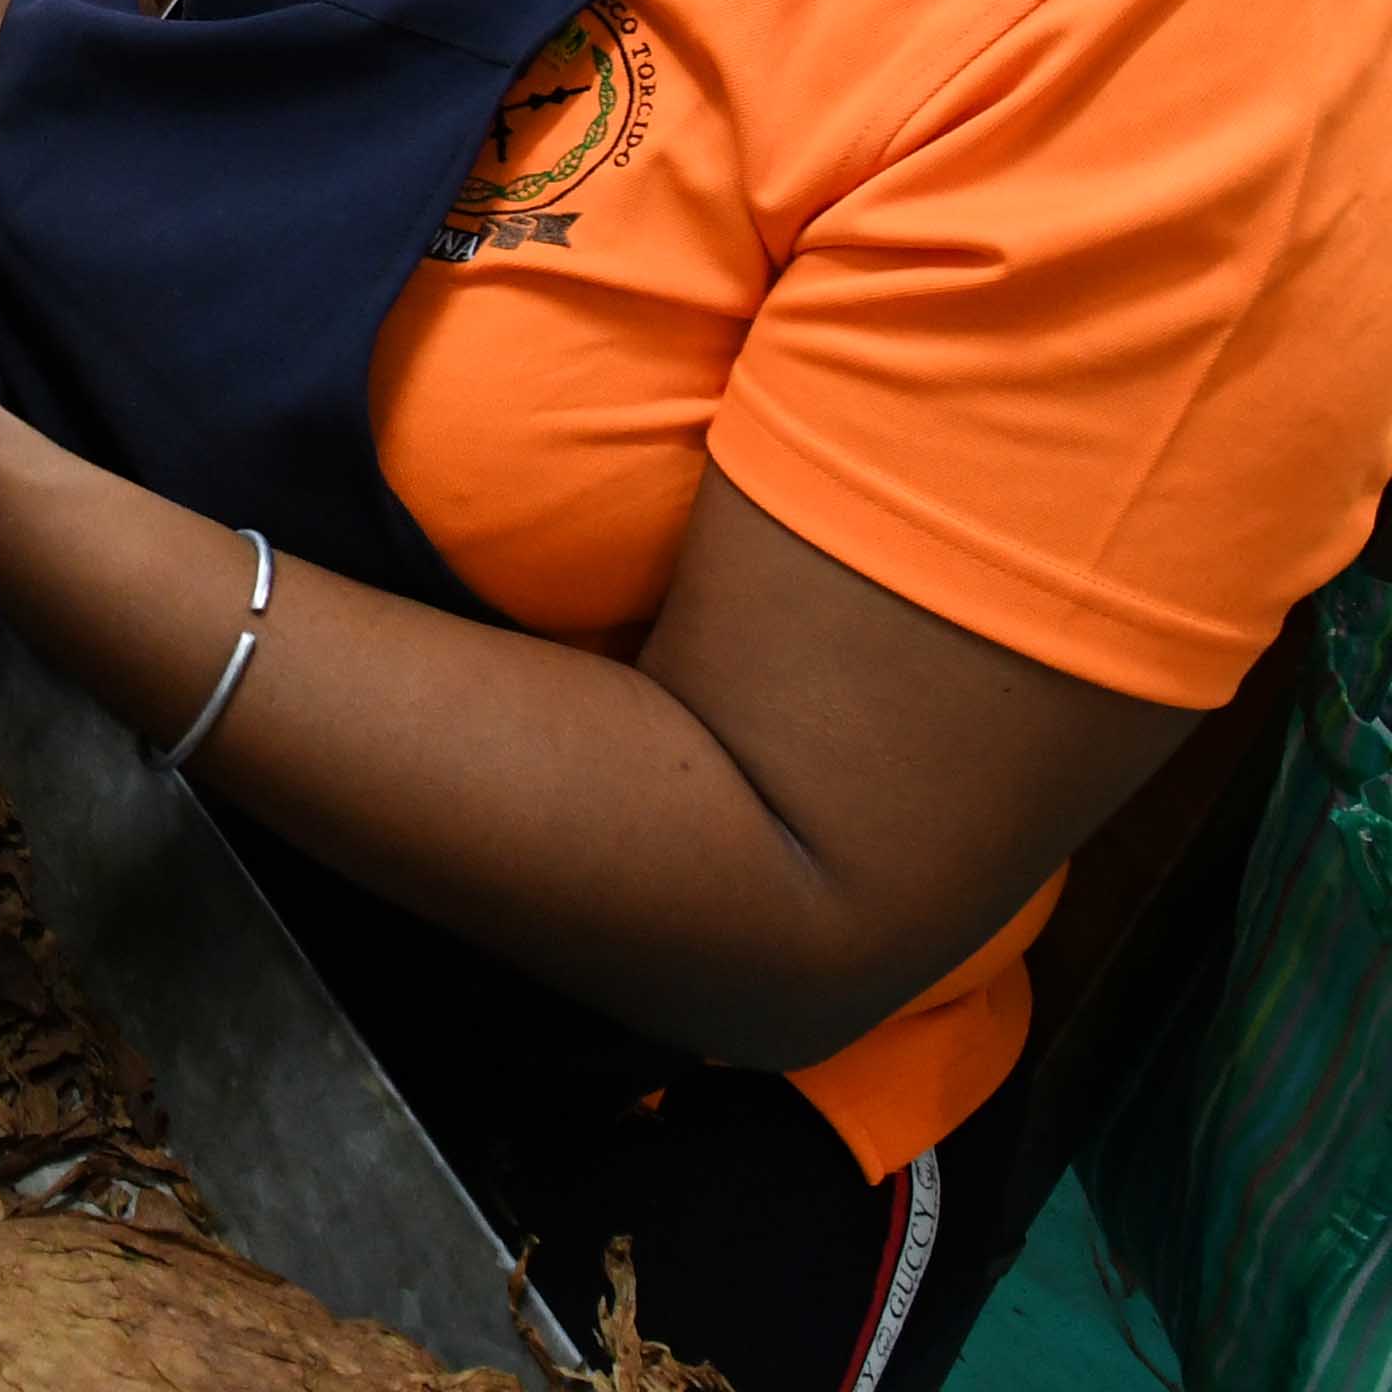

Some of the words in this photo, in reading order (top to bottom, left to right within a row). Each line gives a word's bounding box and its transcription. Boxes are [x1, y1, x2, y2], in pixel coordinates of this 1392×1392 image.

[613, 42, 657, 168] TORCIDO
[429, 229, 479, 260] NA
[889, 1199, 936, 1319] GUCCY
